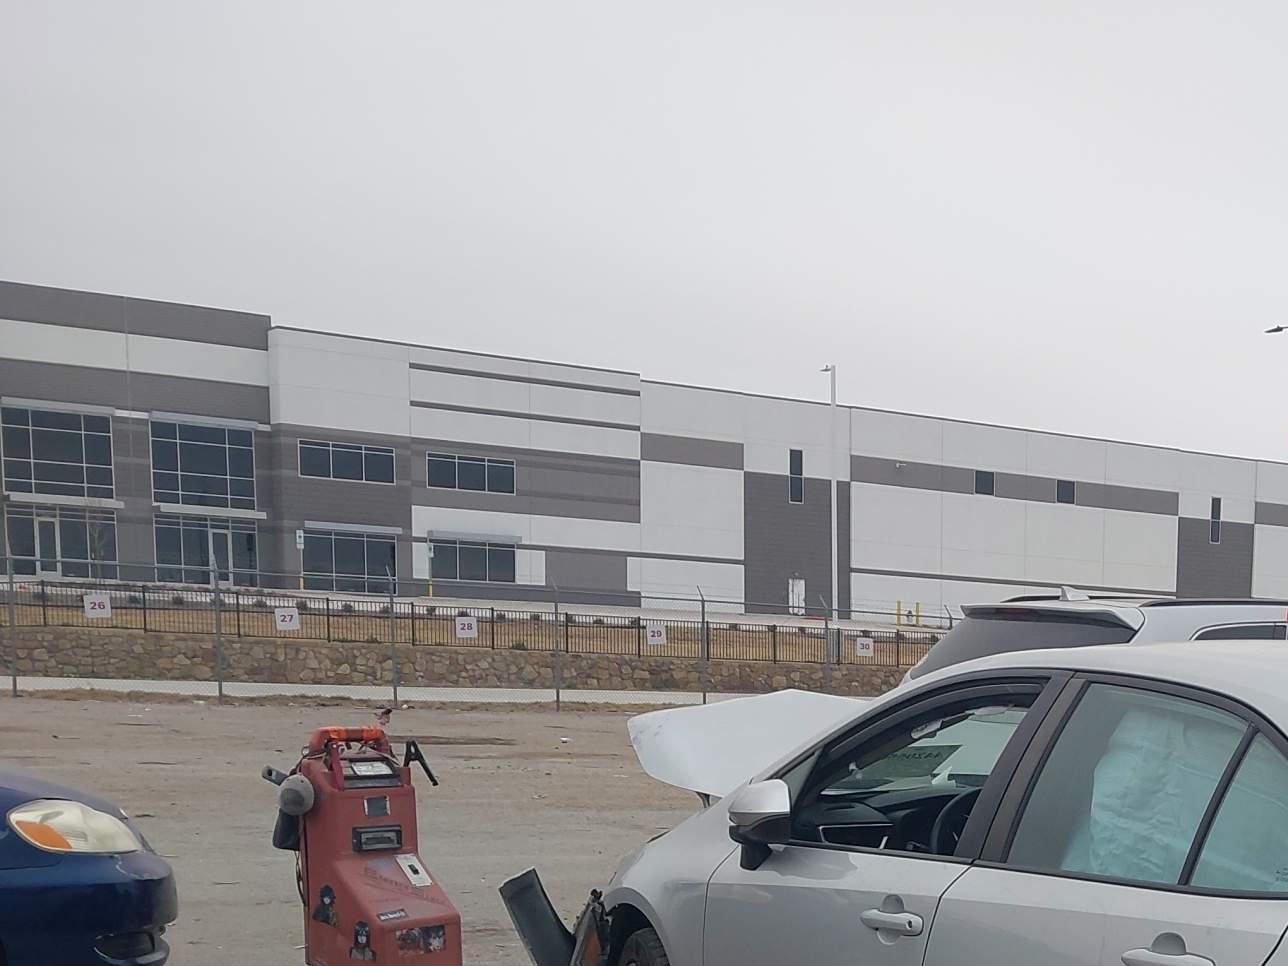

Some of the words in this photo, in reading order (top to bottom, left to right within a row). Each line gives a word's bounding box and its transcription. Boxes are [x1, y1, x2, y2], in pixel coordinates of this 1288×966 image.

[90, 601, 106, 610] 26
[280, 614, 294, 623] 27
[460, 622, 473, 631] 28
[650, 630, 663, 638] 29
[859, 642, 870, 650] 30
